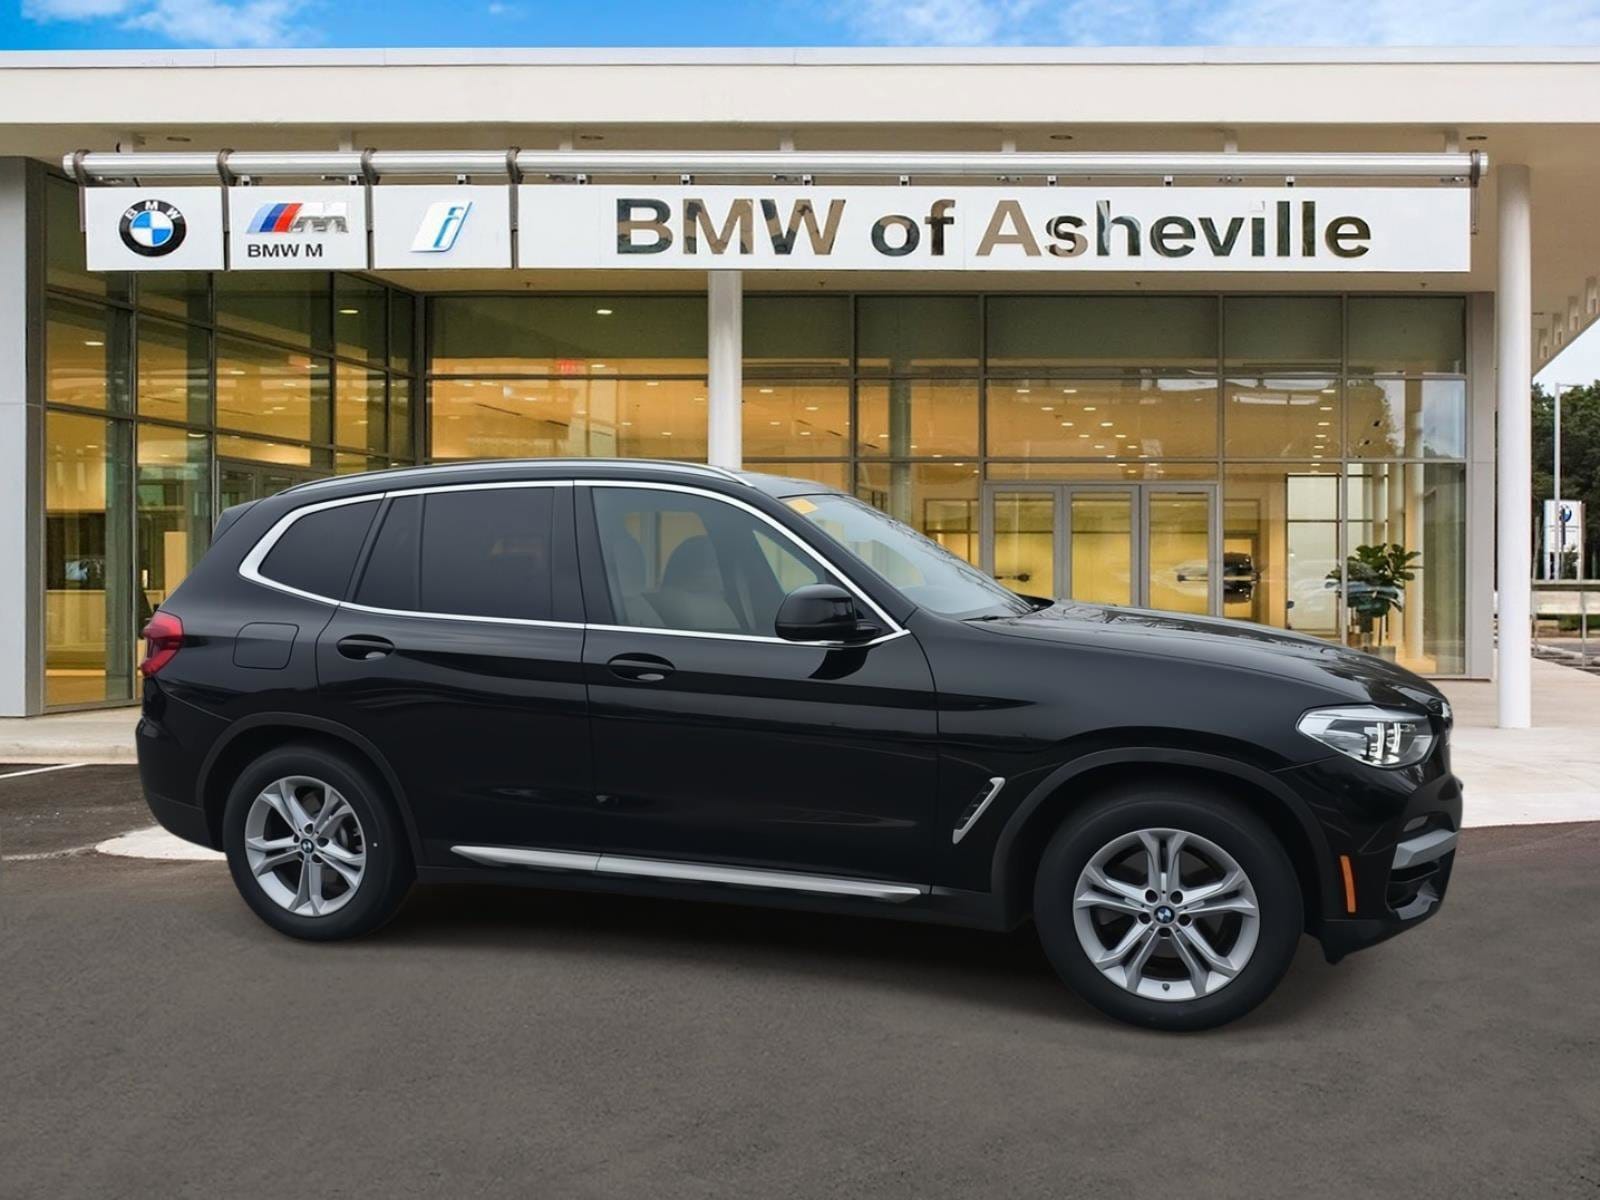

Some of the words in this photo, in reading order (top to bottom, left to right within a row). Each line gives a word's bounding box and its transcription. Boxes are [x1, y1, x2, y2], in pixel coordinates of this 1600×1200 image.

[124, 201, 181, 220] BMW
[616, 198, 846, 255] BMW
[871, 199, 955, 257] of
[975, 199, 1371, 258] Asheville
[247, 243, 300, 258] BMW
[305, 243, 323, 258] M
